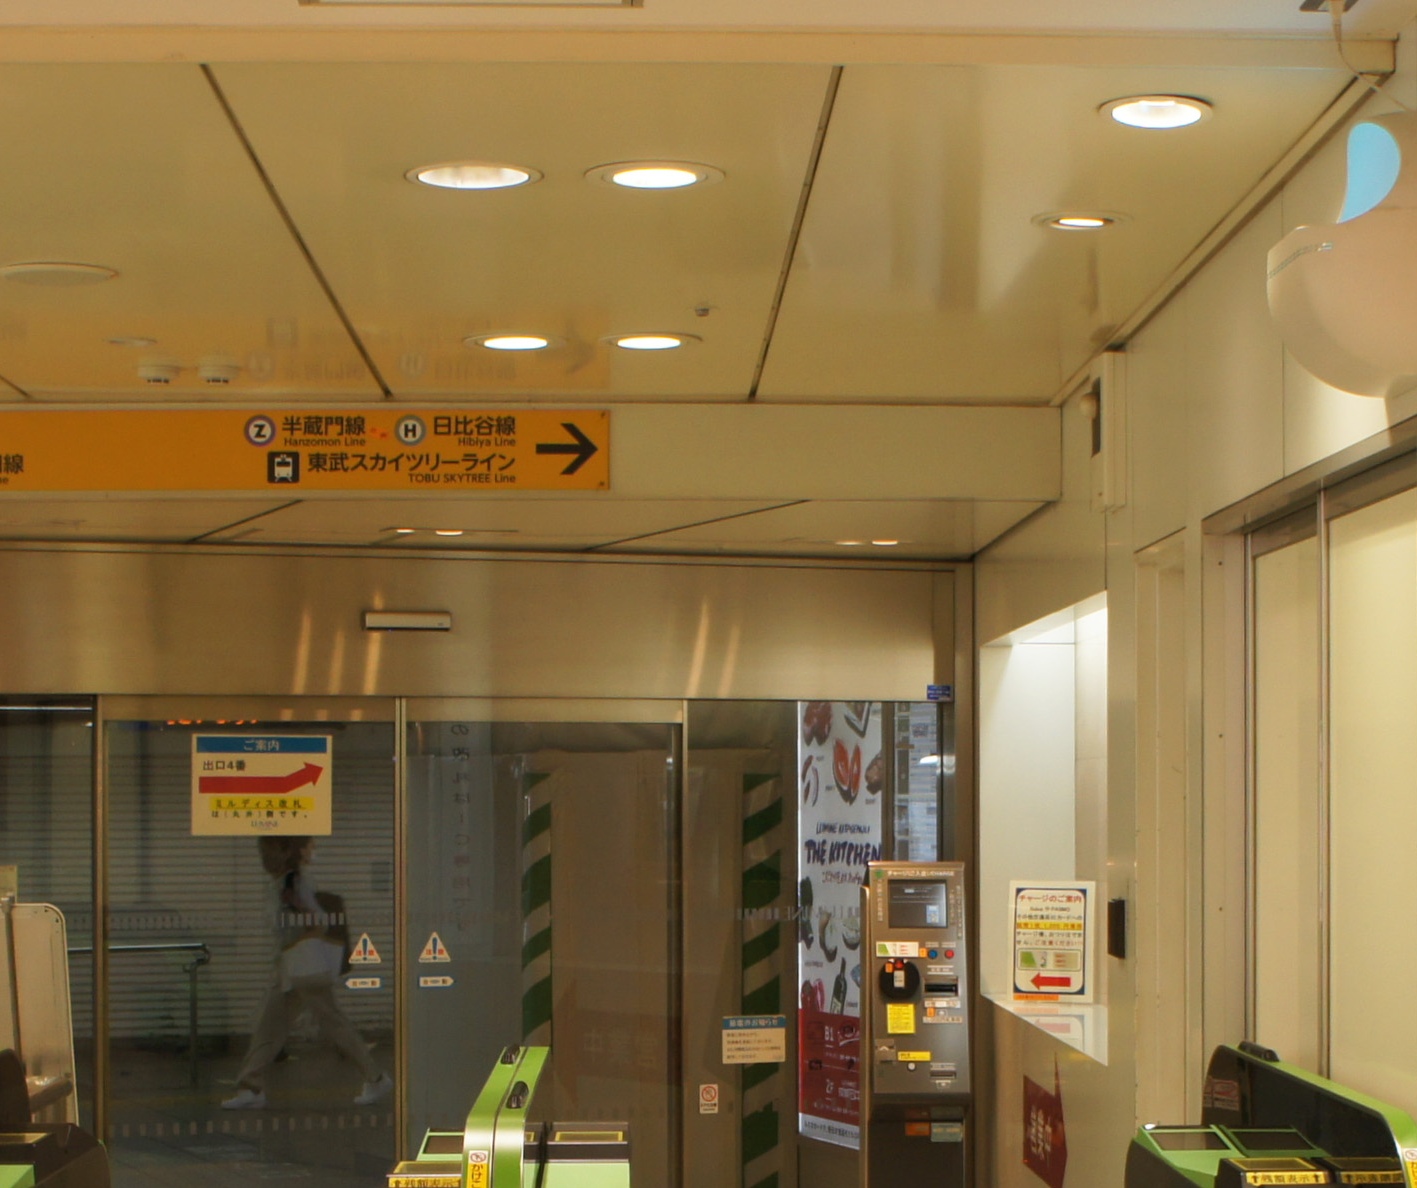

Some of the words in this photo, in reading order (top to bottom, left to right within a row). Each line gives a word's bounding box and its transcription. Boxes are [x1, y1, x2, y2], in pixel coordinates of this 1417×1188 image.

[252, 423, 267, 439] Z
[283, 416, 366, 436] 半蔵門線
[403, 424, 417, 439] H
[434, 416, 516, 436] 日比谷線
[284, 437, 341, 447] Hanzomon
[344, 437, 366, 446] Line
[458, 437, 491, 448] Hibiya
[494, 437, 516, 446] Line
[308, 453, 516, 473] 東武スカイツリーライン
[408, 473, 440, 483] TOBU
[443, 473, 491, 483] SKYTREE
[494, 473, 516, 483] Line
[243, 739, 280, 752] ご案内
[203, 760, 246, 771] 出口4番
[804, 838, 827, 866] THE
[828, 838, 882, 867] KITCHEN
